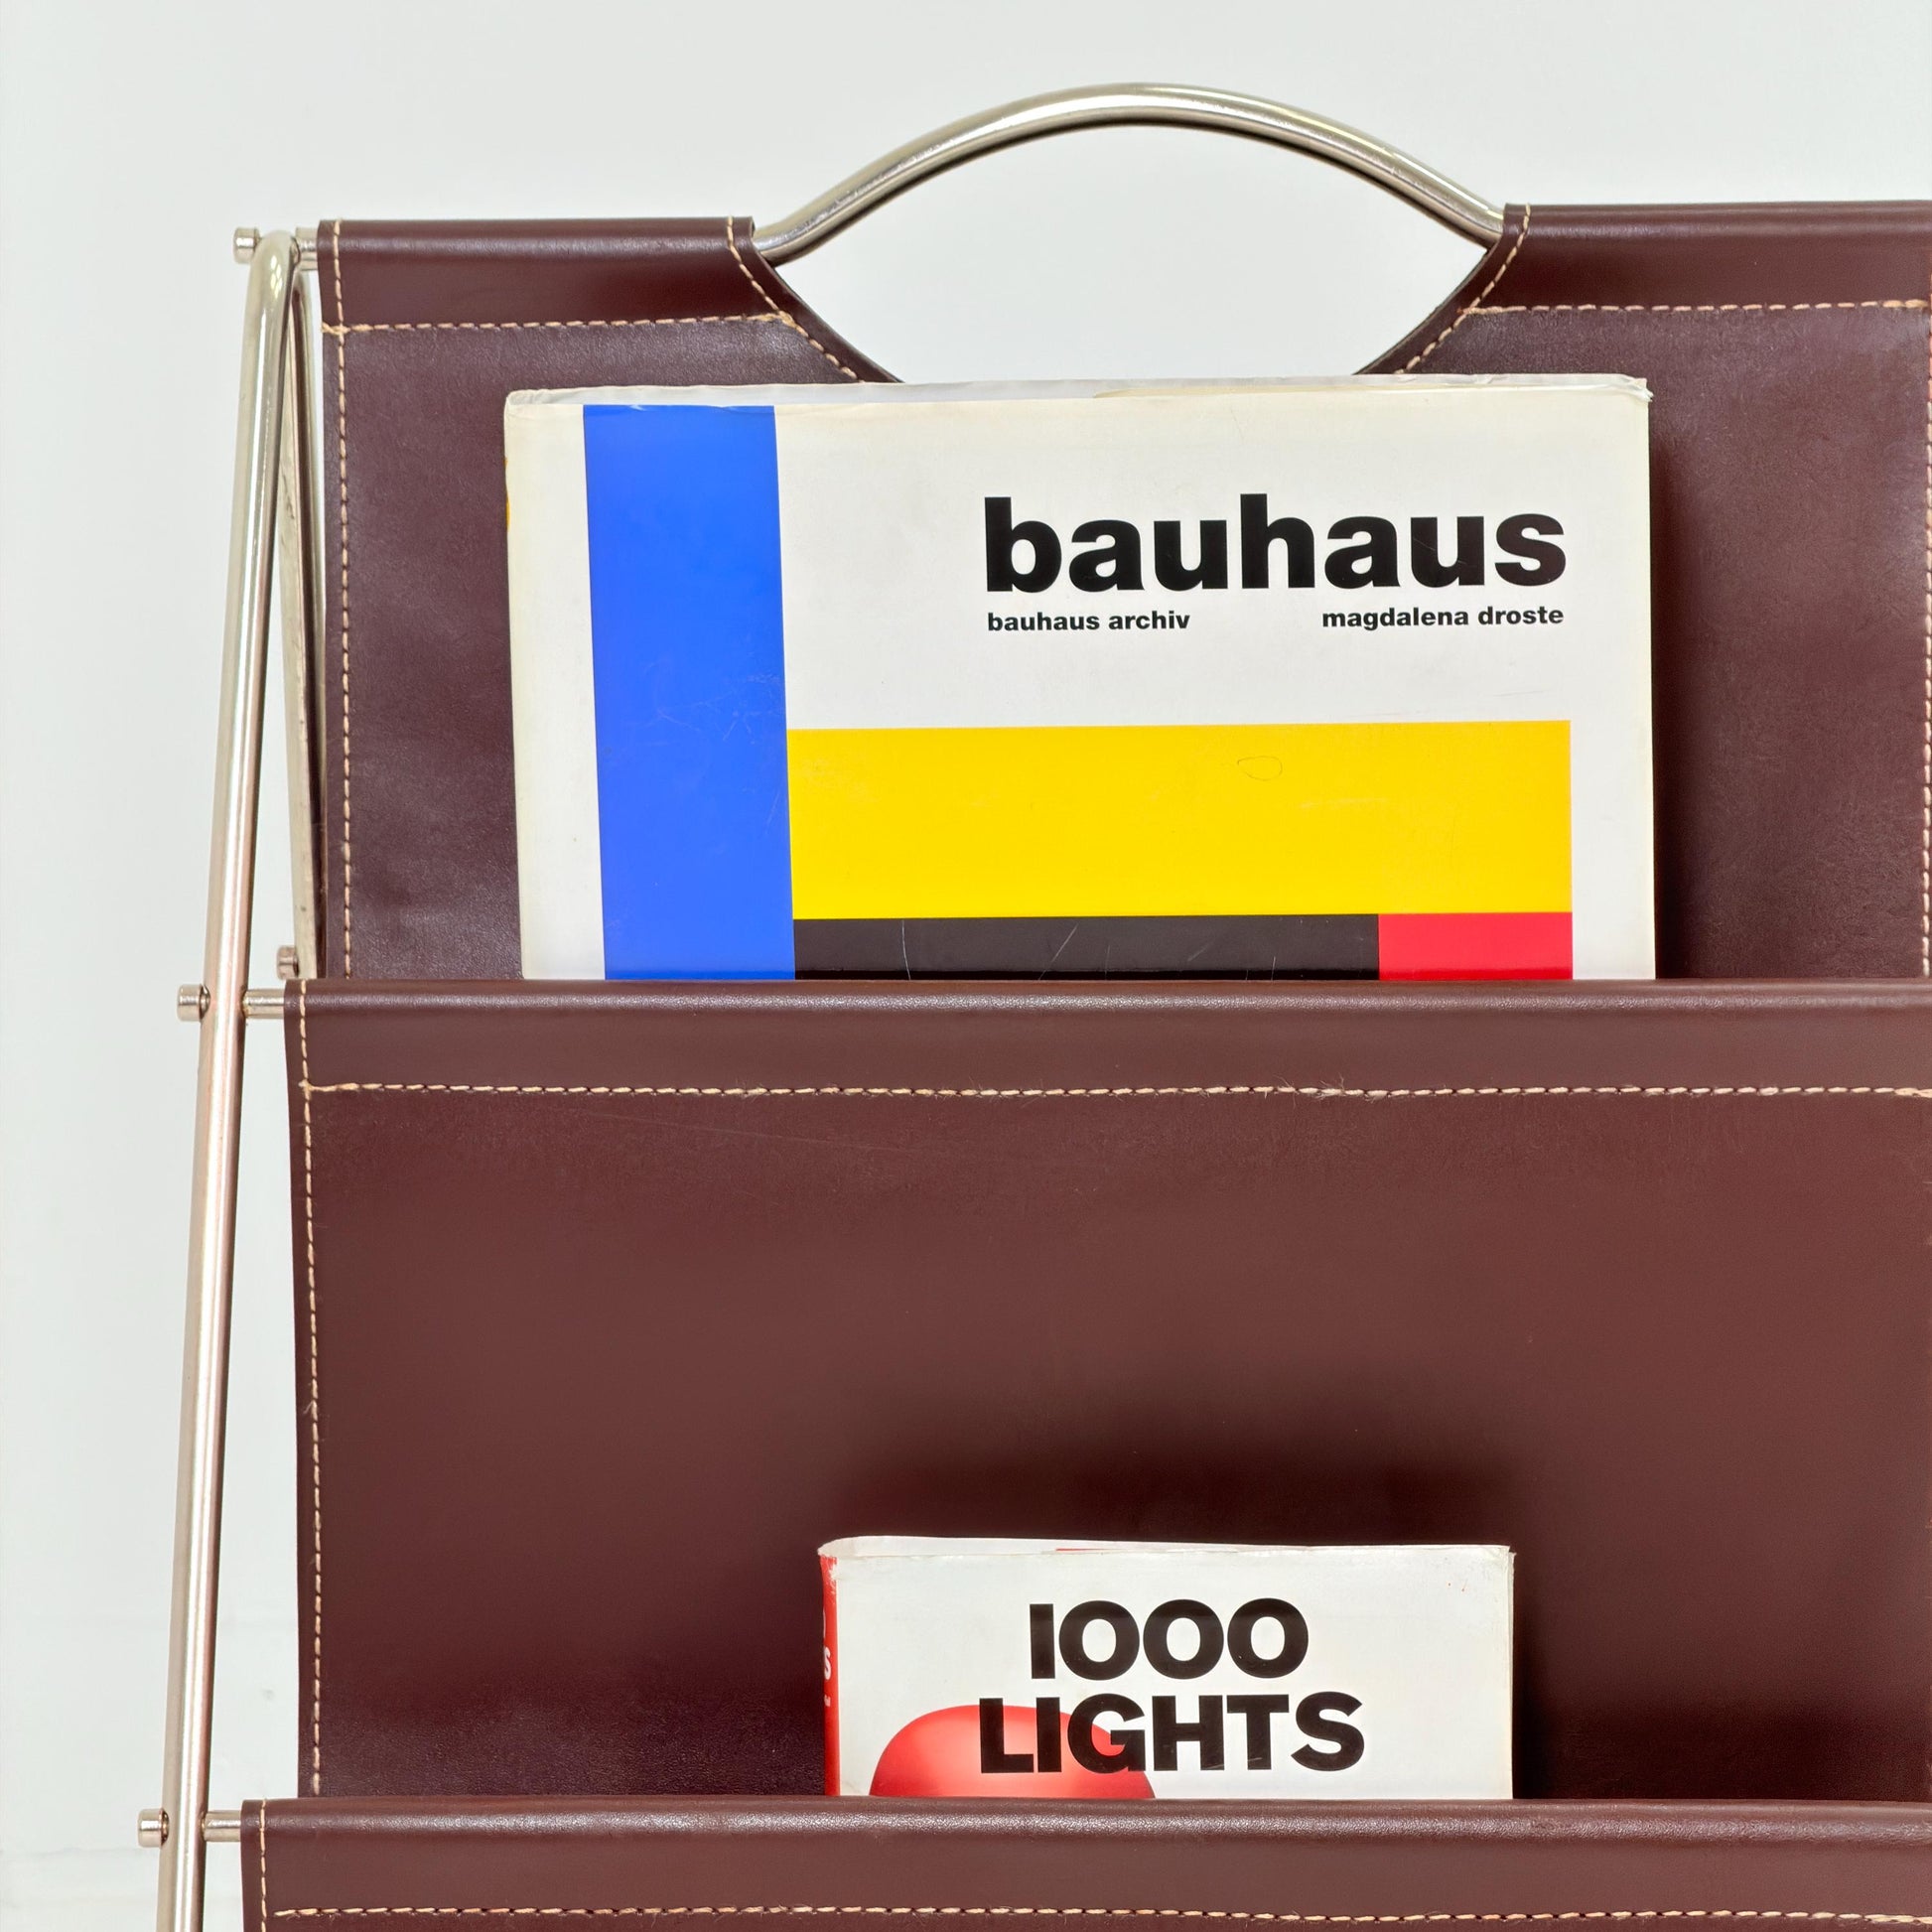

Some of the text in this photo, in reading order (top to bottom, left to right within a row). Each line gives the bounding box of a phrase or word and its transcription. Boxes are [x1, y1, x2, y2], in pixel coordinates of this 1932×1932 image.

[984, 492, 1566, 594] bauhaus
[988, 610, 1190, 631] bauhaus archiv
[1321, 605, 1564, 631] magdalena droste
[1030, 1597, 1309, 1680] 1000
[980, 1692, 1365, 1774] LIGHTS
